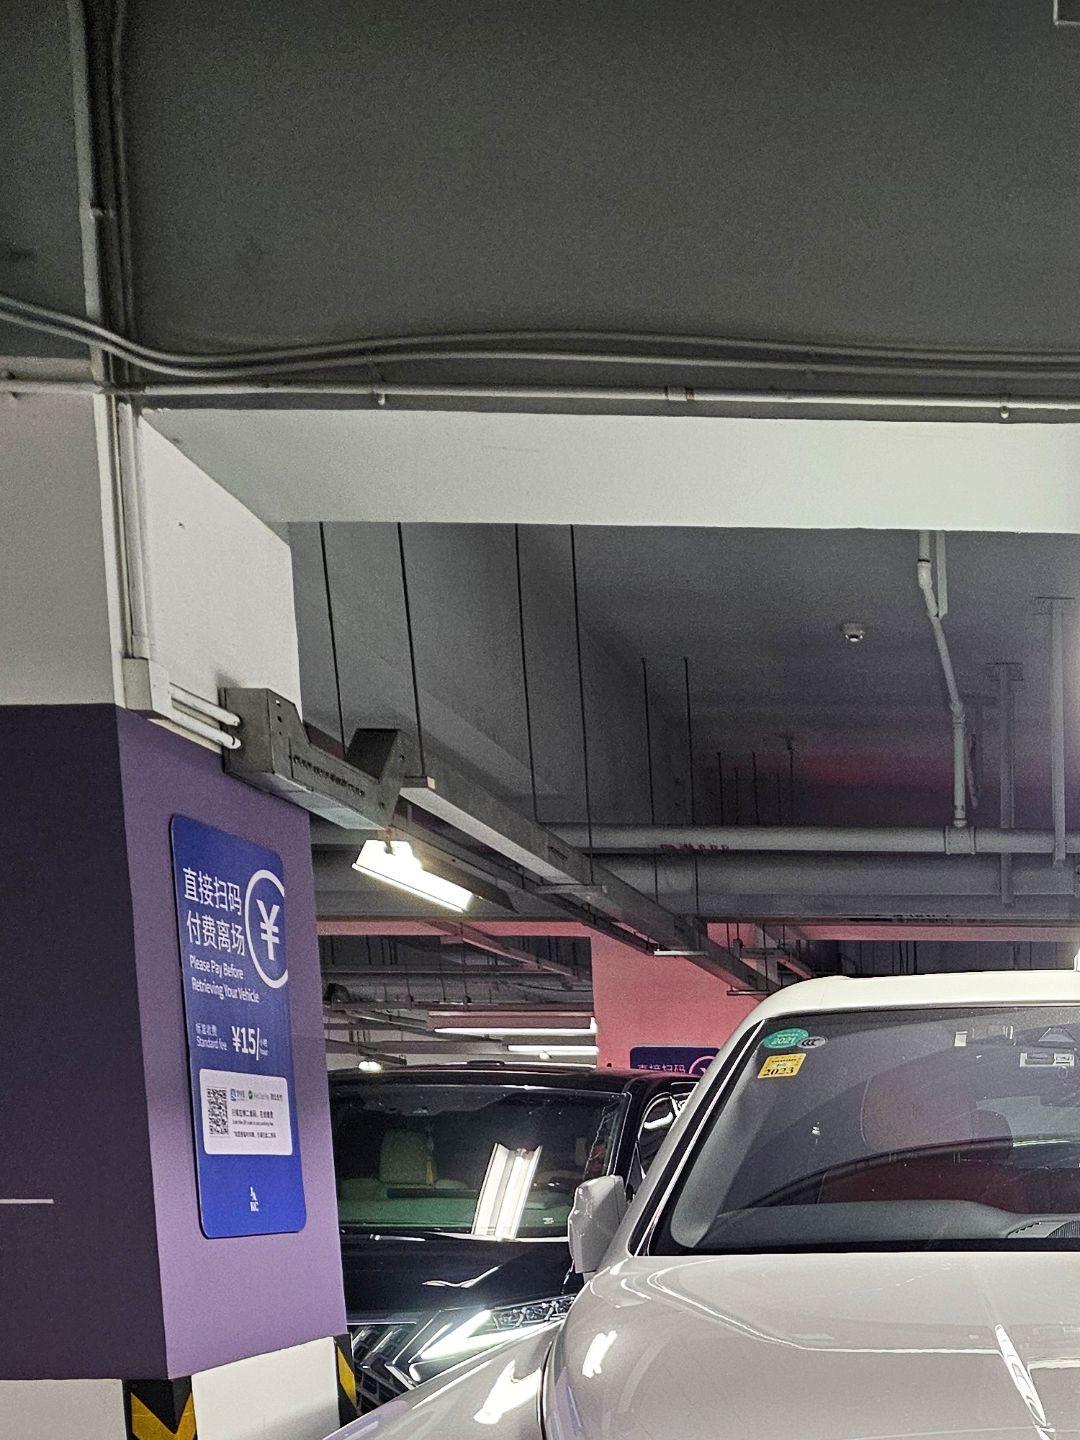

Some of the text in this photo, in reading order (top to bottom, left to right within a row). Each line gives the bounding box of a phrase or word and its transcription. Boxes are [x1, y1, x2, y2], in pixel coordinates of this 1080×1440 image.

[183, 867, 242, 916] 直接扫码
[187, 910, 245, 956] 付费离场
[190, 954, 244, 980] Please Pay Before
[191, 977, 260, 1003] Retrieving Your Vehicle
[763, 1067, 794, 1076] 2023
